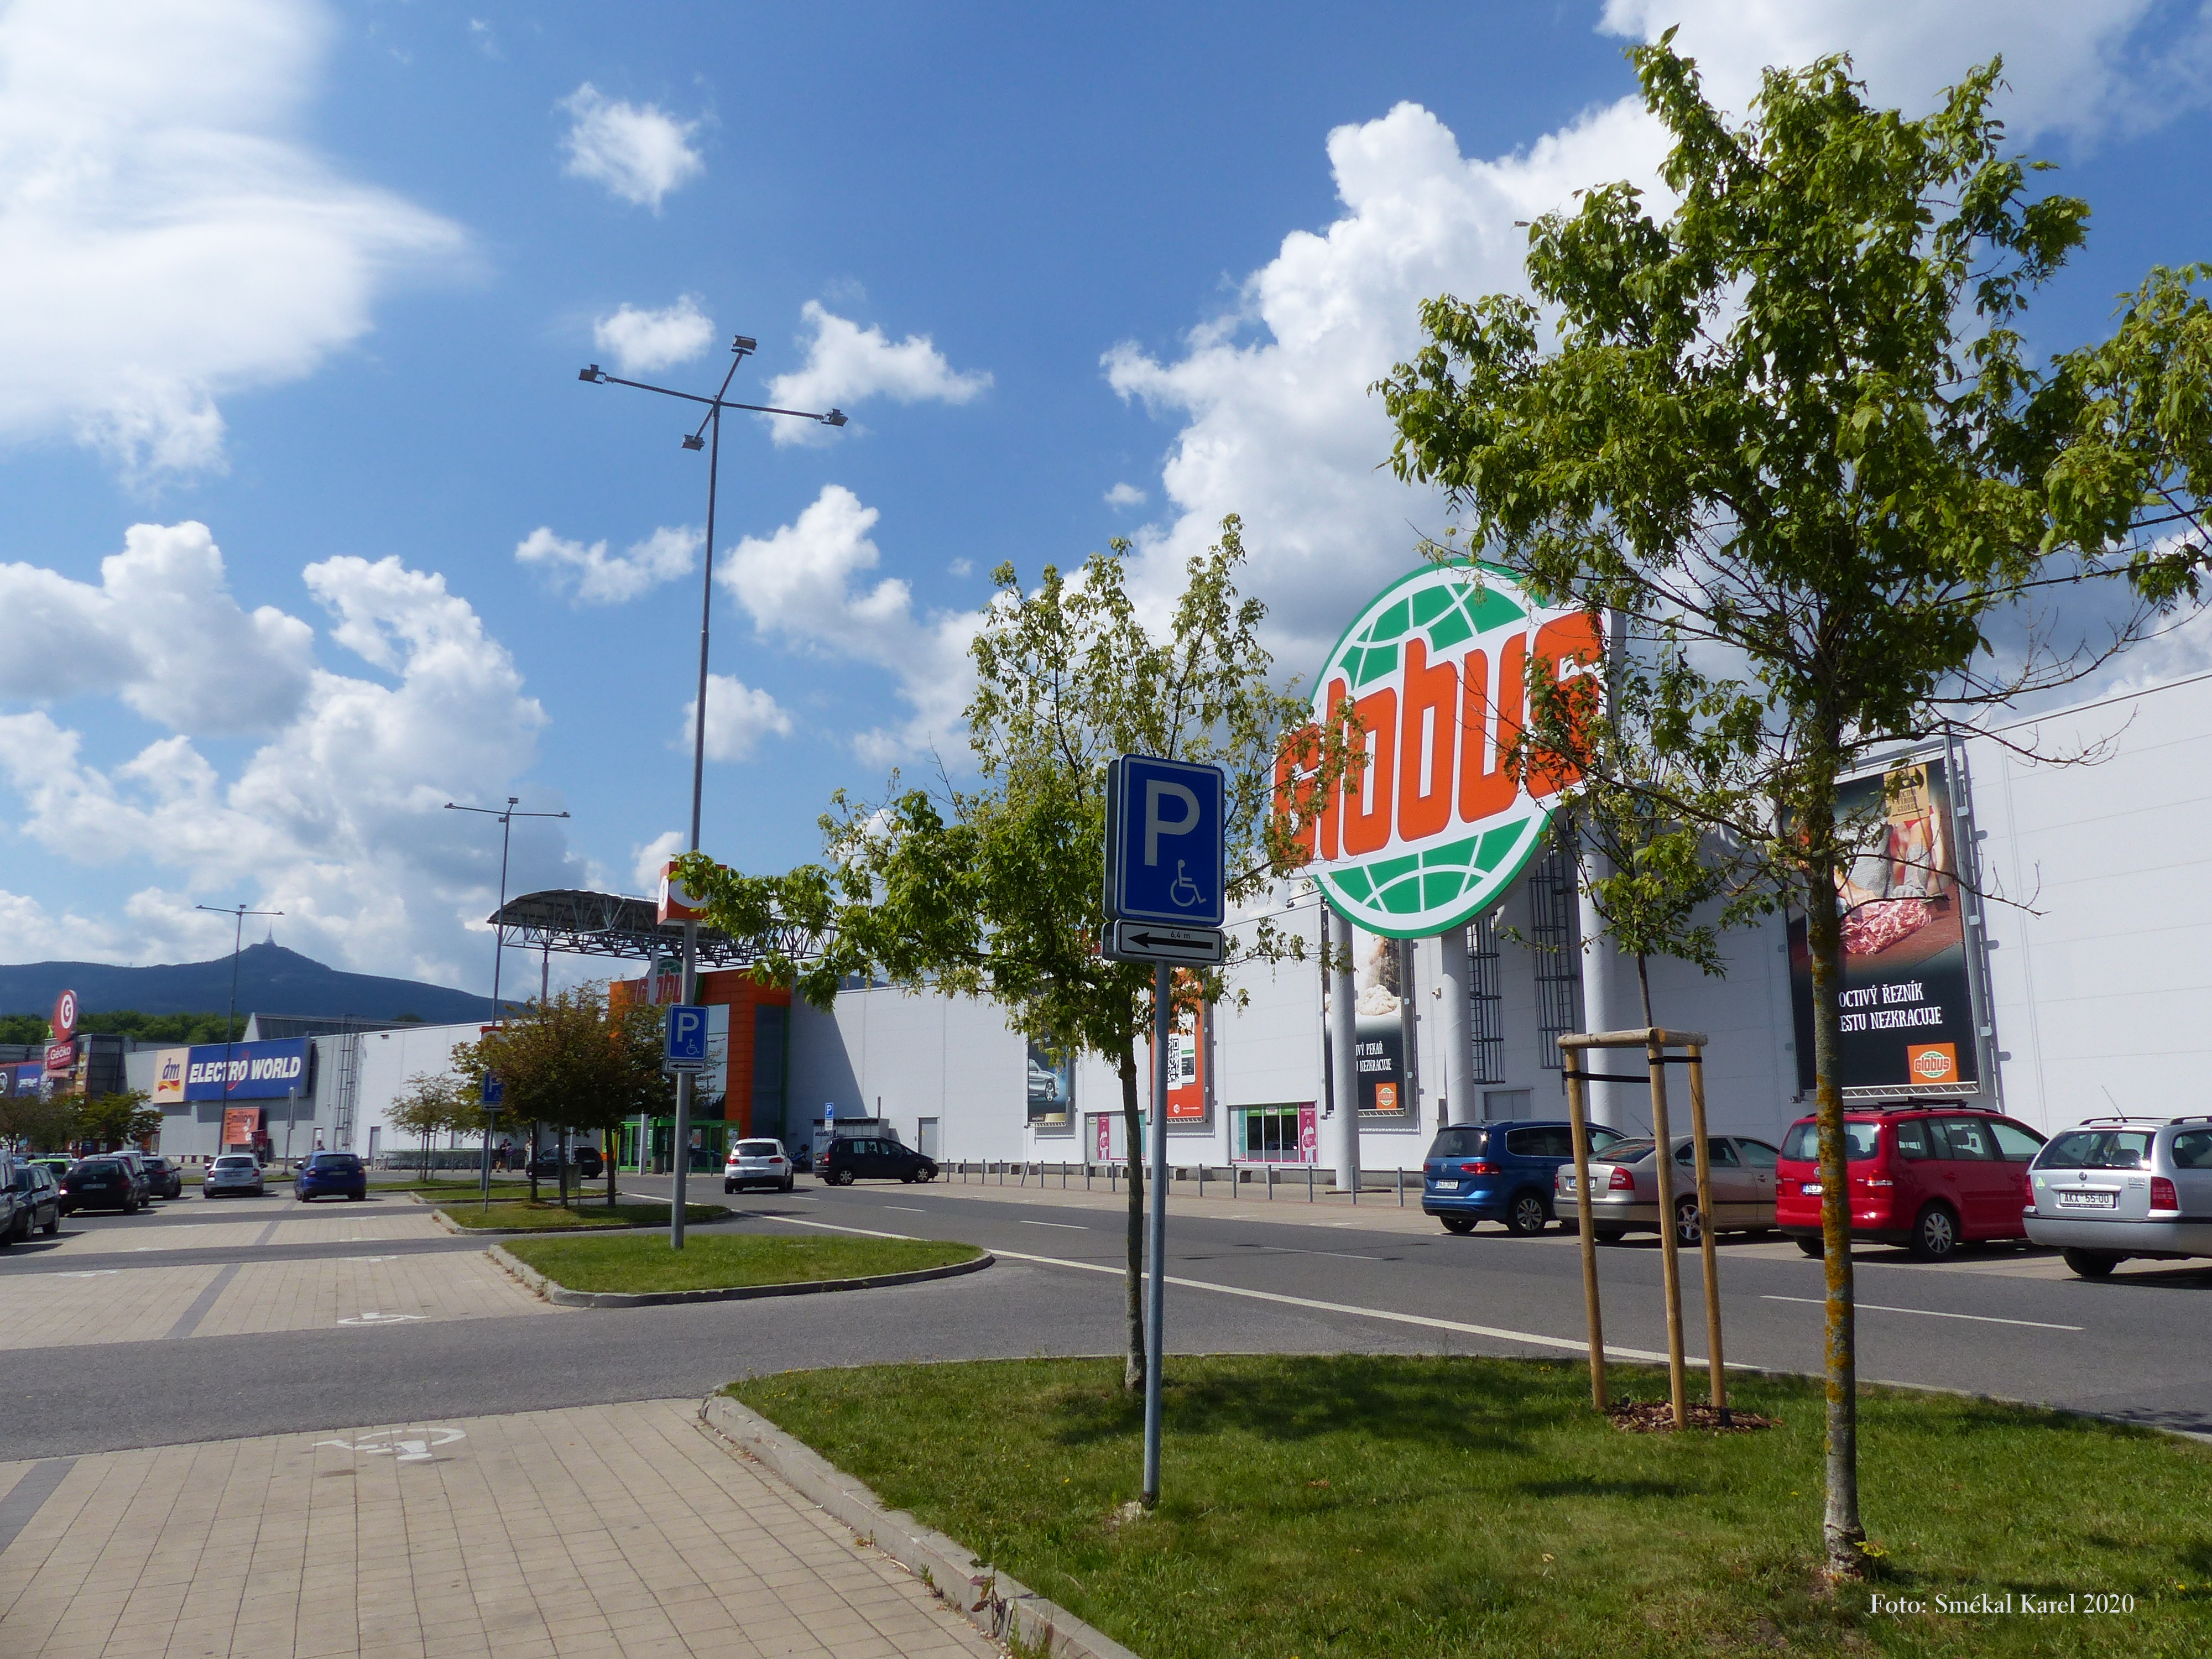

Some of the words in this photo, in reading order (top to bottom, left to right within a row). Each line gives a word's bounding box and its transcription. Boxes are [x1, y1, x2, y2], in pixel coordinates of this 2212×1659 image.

[1145, 779, 1201, 867] P
[1839, 984, 1877, 1008] OCTIVÝ
[1882, 980, 1924, 1004] ŘEZNÍK
[677, 1013, 699, 1042] P
[1840, 1014, 1866, 1032] ESTU
[1870, 1006, 1943, 1029] NEZKRACUJE
[1366, 1041, 1384, 1055] PEKAŘ
[163, 1057, 180, 1079] dm
[189, 1060, 248, 1083] ELECTRO
[251, 1057, 301, 1079] WORLD
[1360, 1058, 1392, 1072] NEZKRACUJE
[827, 1105, 832, 1114] P
[2065, 1193, 2079, 1203] AKX
[2085, 1194, 2109, 1203] 55-00
